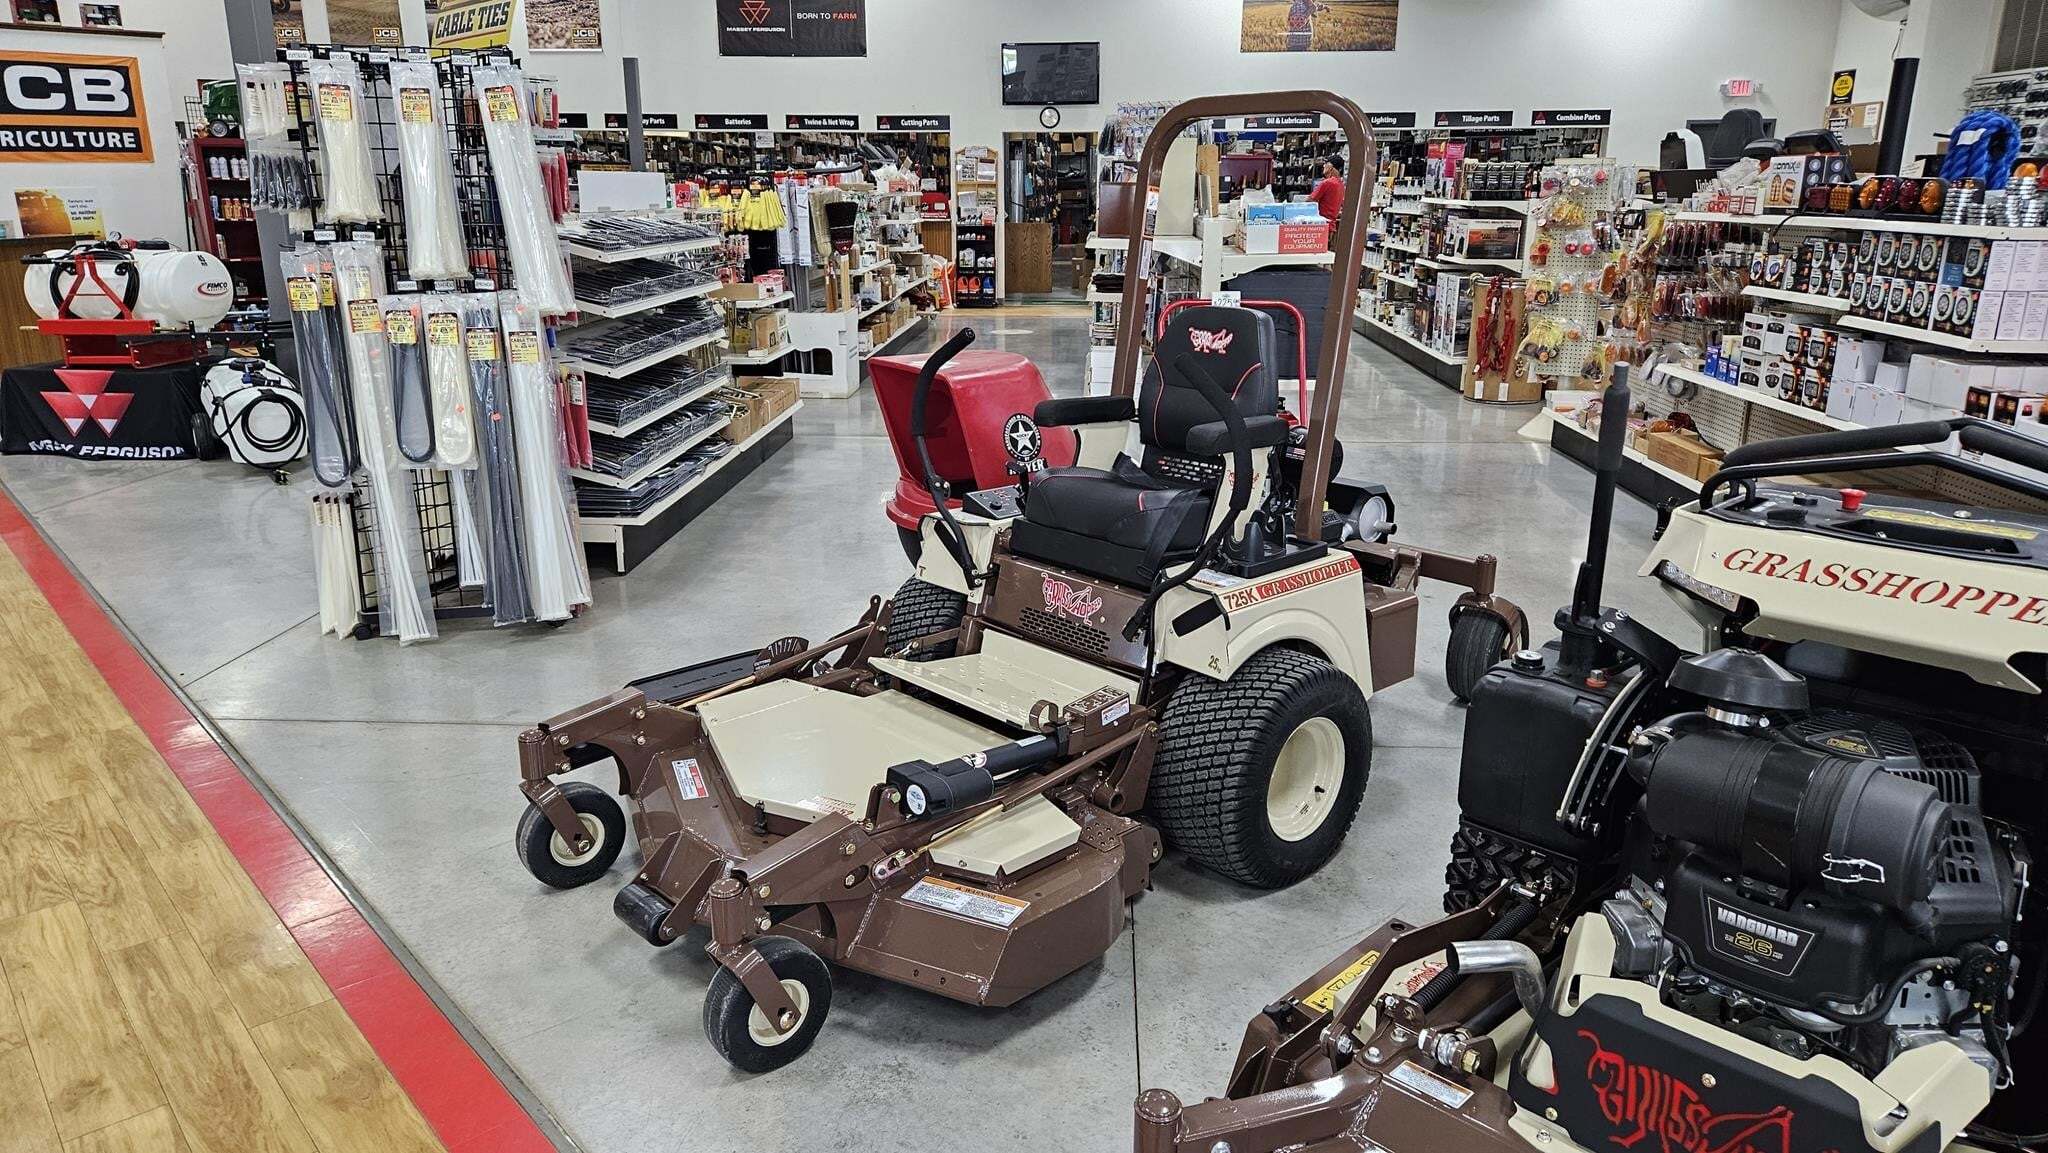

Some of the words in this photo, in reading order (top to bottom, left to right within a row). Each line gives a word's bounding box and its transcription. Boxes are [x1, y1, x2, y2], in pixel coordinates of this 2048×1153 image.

[435, 10, 475, 39] CABLE
[477, 1, 513, 30] TIES
[821, 12, 831, 20] TO
[832, 12, 857, 20] FARM
[278, 29, 301, 37] JCB
[375, 29, 398, 37] JCB
[573, 29, 596, 37] JCB
[3, 64, 130, 112] CB
[1731, 79, 1751, 95] EXIT
[1281, 116, 1313, 124] Lubricants
[1371, 116, 1398, 125] Lighting
[1462, 115, 1483, 123] Tillage
[1556, 113, 1583, 121] Combine
[1583, 113, 1601, 121] Parts
[838, 118, 855, 127] Wrap
[901, 118, 922, 127] Cutting
[922, 118, 939, 126] Parts
[0, 130, 137, 149] RICULTURE
[1223, 587, 1259, 610] 725K
[1261, 558, 1355, 597] GRASSHOPPER
[1722, 547, 2048, 627] GRASSHOPPE
[1207, 654, 1220, 670] 25
[1717, 906, 1800, 947] VANGUARD
[1734, 931, 1773, 957] 26
